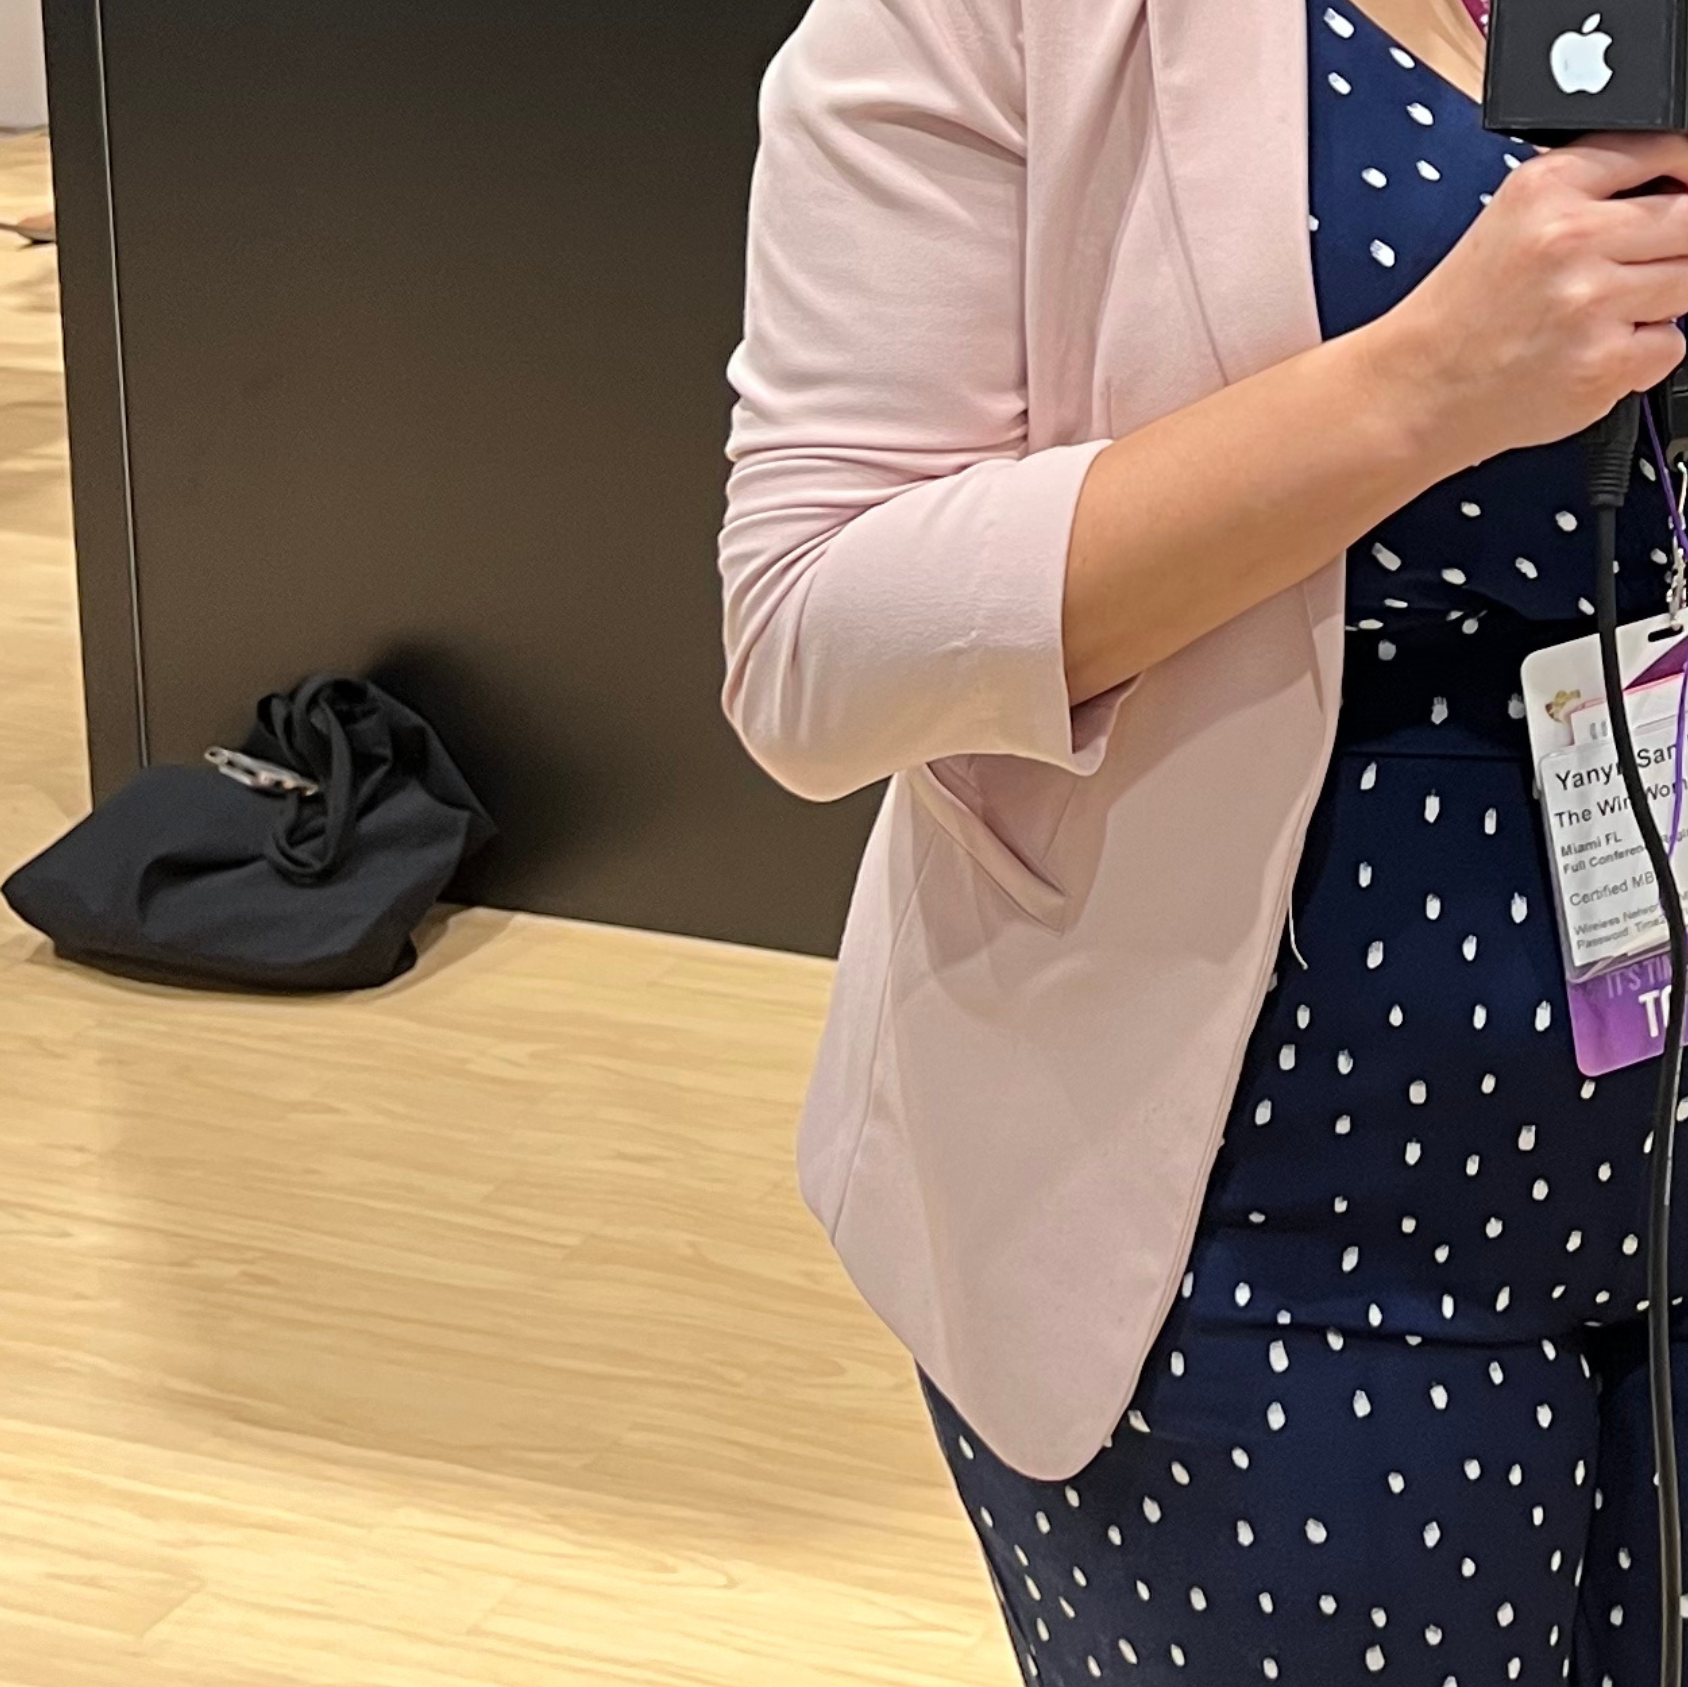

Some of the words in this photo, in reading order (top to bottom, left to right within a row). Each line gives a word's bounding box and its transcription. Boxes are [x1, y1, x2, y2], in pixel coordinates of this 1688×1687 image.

[1554, 808, 1592, 829] The
[1560, 837, 1602, 857] Miami
[1604, 830, 1623, 845] FL
[1563, 859, 1587, 875] Full
